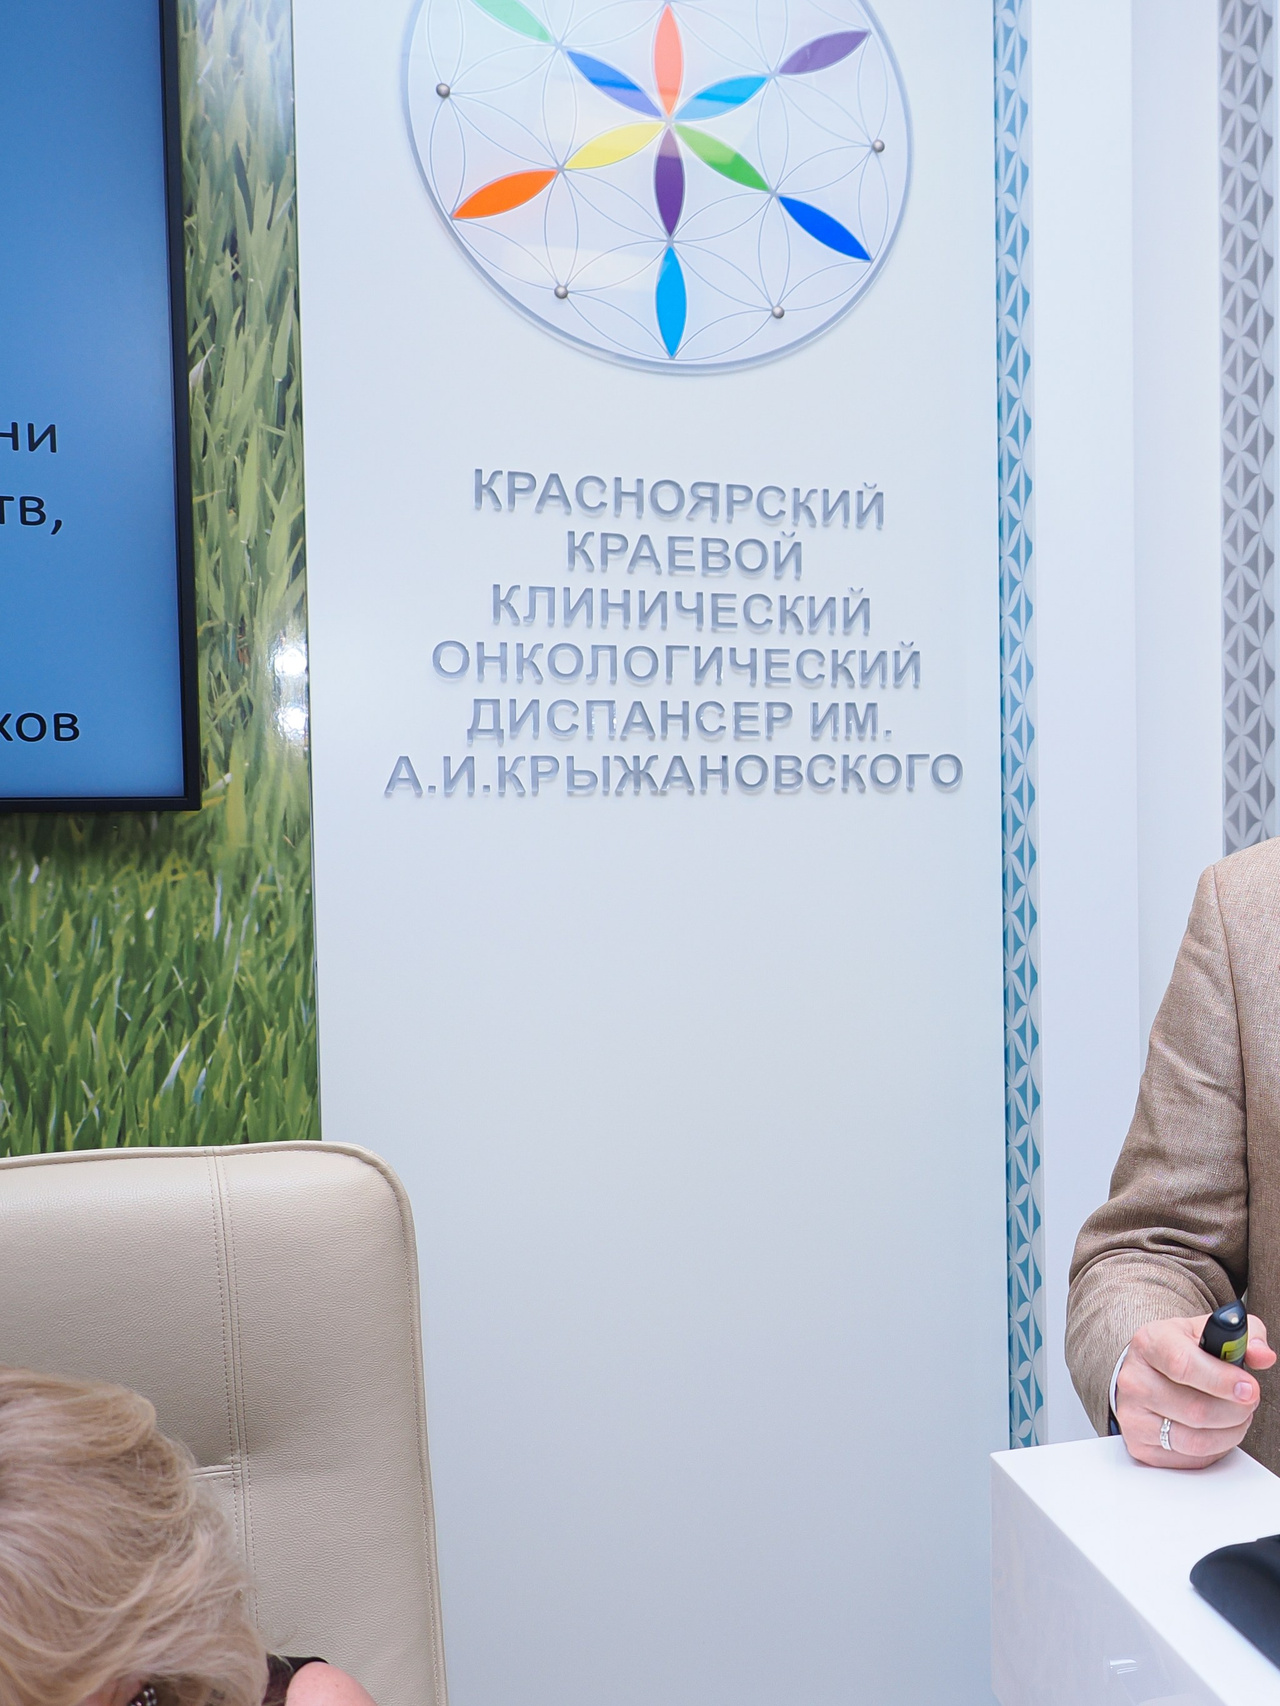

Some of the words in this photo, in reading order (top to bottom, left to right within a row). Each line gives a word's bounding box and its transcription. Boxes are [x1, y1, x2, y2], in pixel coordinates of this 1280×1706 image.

[473, 467, 886, 530] КРАСНОЯРСКИЙ
[565, 529, 803, 580] КРАЕВОЙ
[491, 583, 872, 636] КЛИНИЧЕСКИЙ
[431, 639, 923, 689] ОНКОЛОГИЧЕСКИЙ
[466, 697, 795, 747] ДИСПАНСЕР
[809, 701, 893, 742] ИМ.
[384, 752, 965, 796] А.И.КРЫЖАНОВСКОГО
